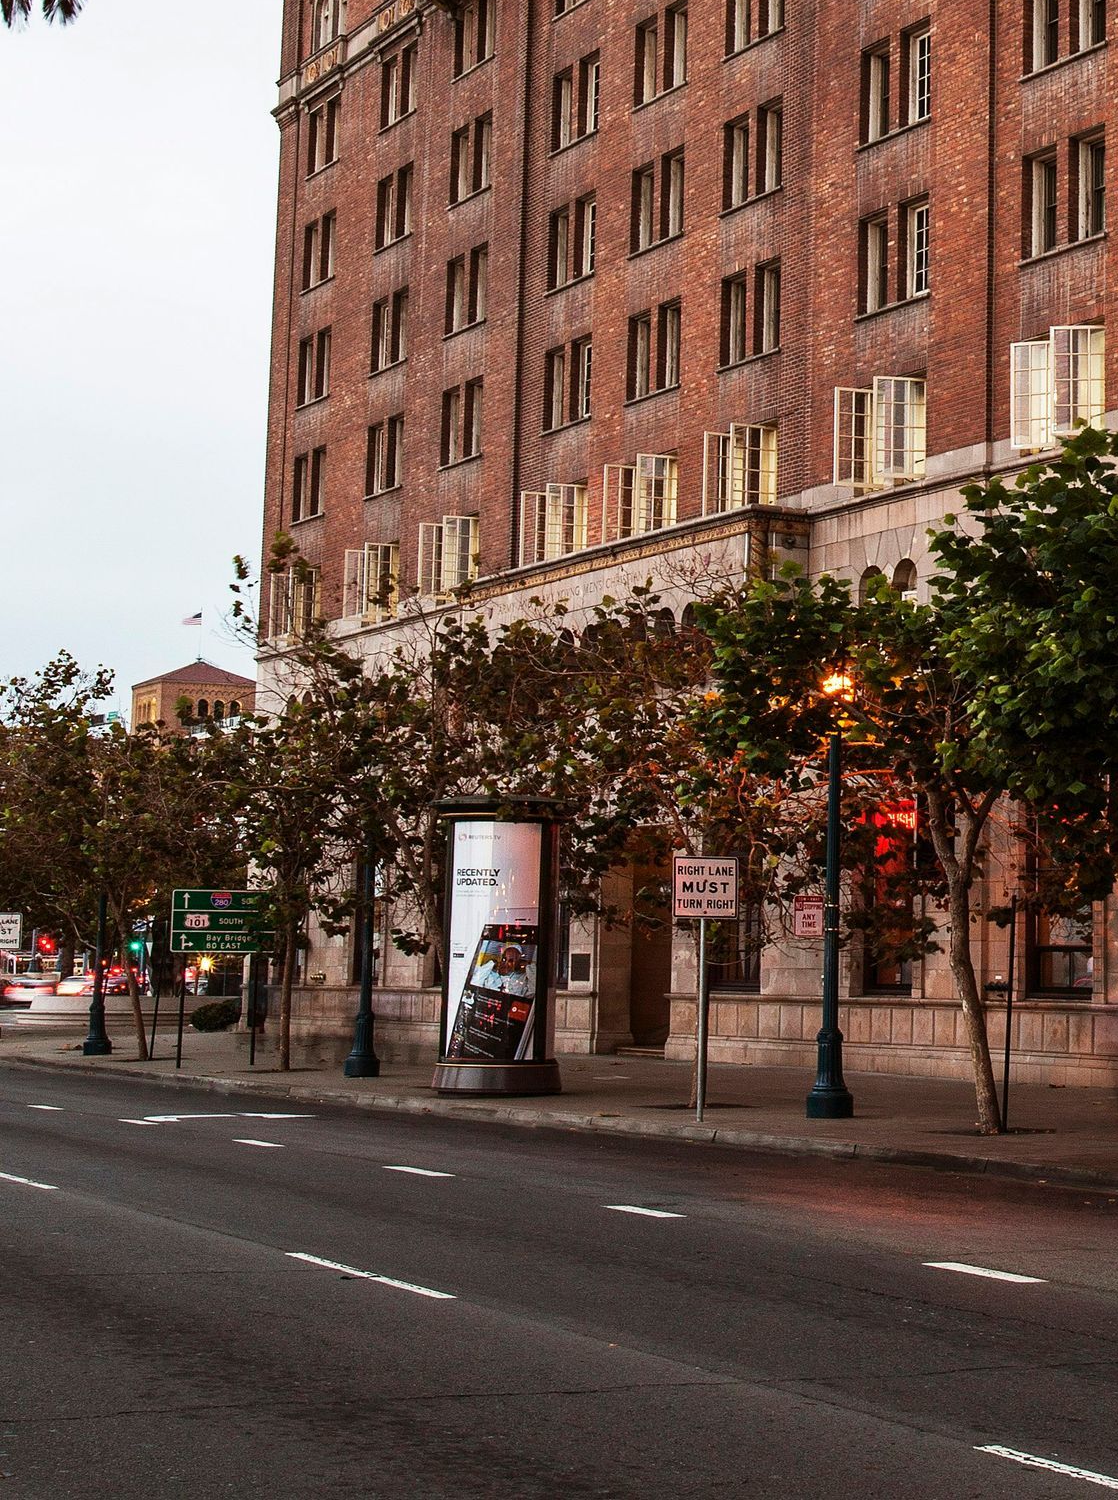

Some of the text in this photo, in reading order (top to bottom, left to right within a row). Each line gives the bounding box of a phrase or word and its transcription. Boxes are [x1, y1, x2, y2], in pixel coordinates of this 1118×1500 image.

[456, 868, 501, 877] RECENTLY
[677, 865, 734, 877] RIGHT LANE
[456, 878, 499, 887] UPDATED.
[682, 880, 730, 894] MUST
[677, 898, 735, 910] TURN RIGHT
[189, 917, 244, 927] 101 SOUTH
[206, 934, 252, 942] Bay Bridge
